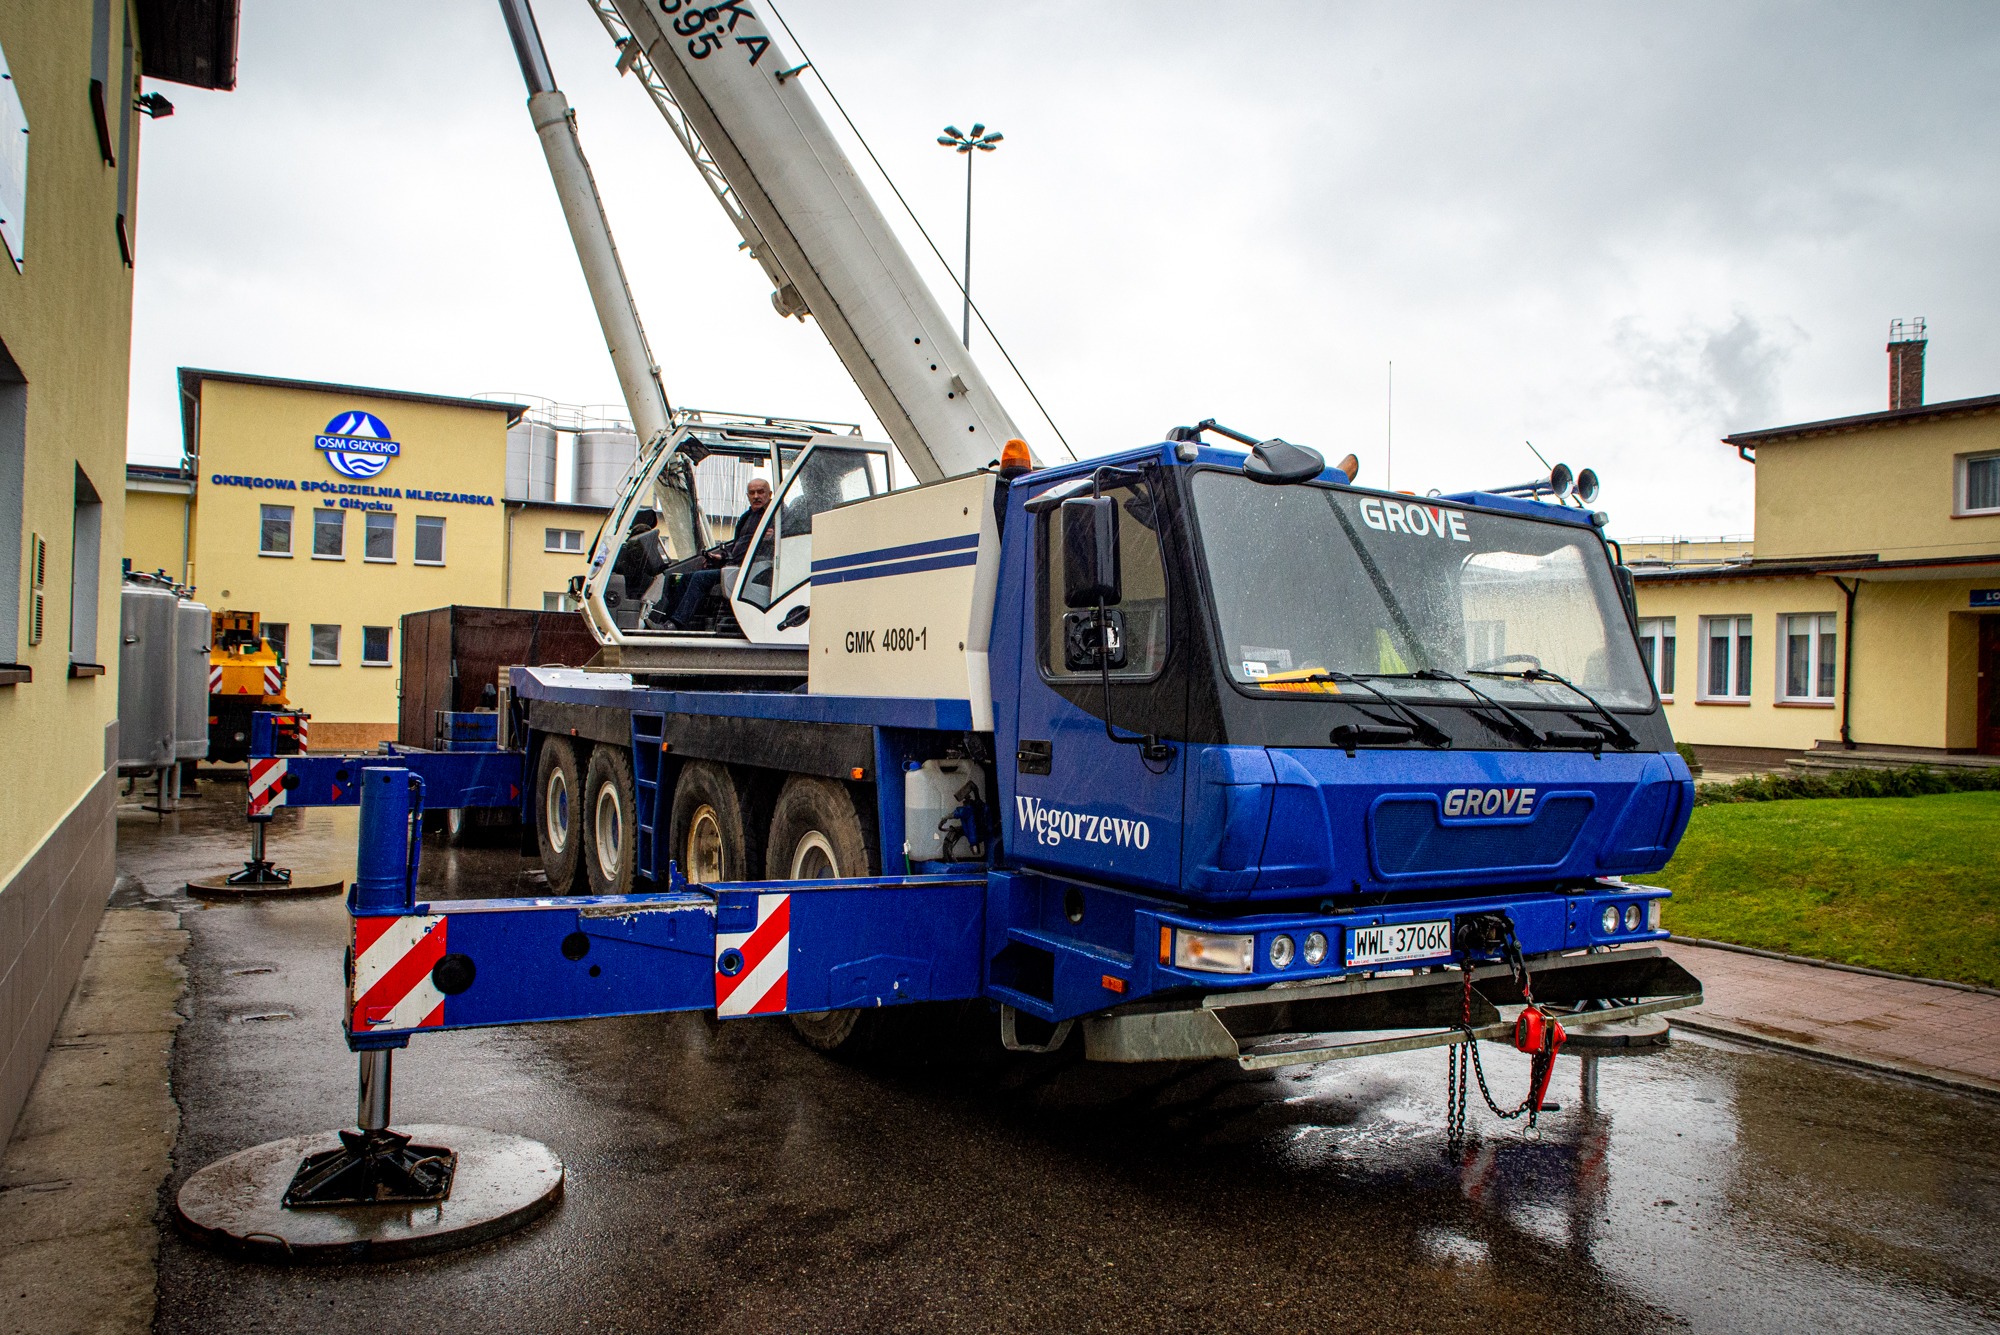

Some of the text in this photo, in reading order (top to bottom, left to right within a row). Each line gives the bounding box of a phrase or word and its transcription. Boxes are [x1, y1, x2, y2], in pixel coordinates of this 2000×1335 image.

[317, 437, 398, 453] OSM GIŻYCKO
[211, 474, 495, 506] OKRĘGOWA SPÓŁDZIELNIA MLECZARSKA
[323, 497, 393, 512] w Giżycku
[1359, 497, 1471, 542] GROVE
[845, 626, 927, 653] GMK 4080-1
[1444, 788, 1536, 816] GROVE
[1015, 795, 1150, 850] Węgorzewo
[1346, 948, 1354, 956] PL
[1356, 924, 1448, 957] WWL 3706K
